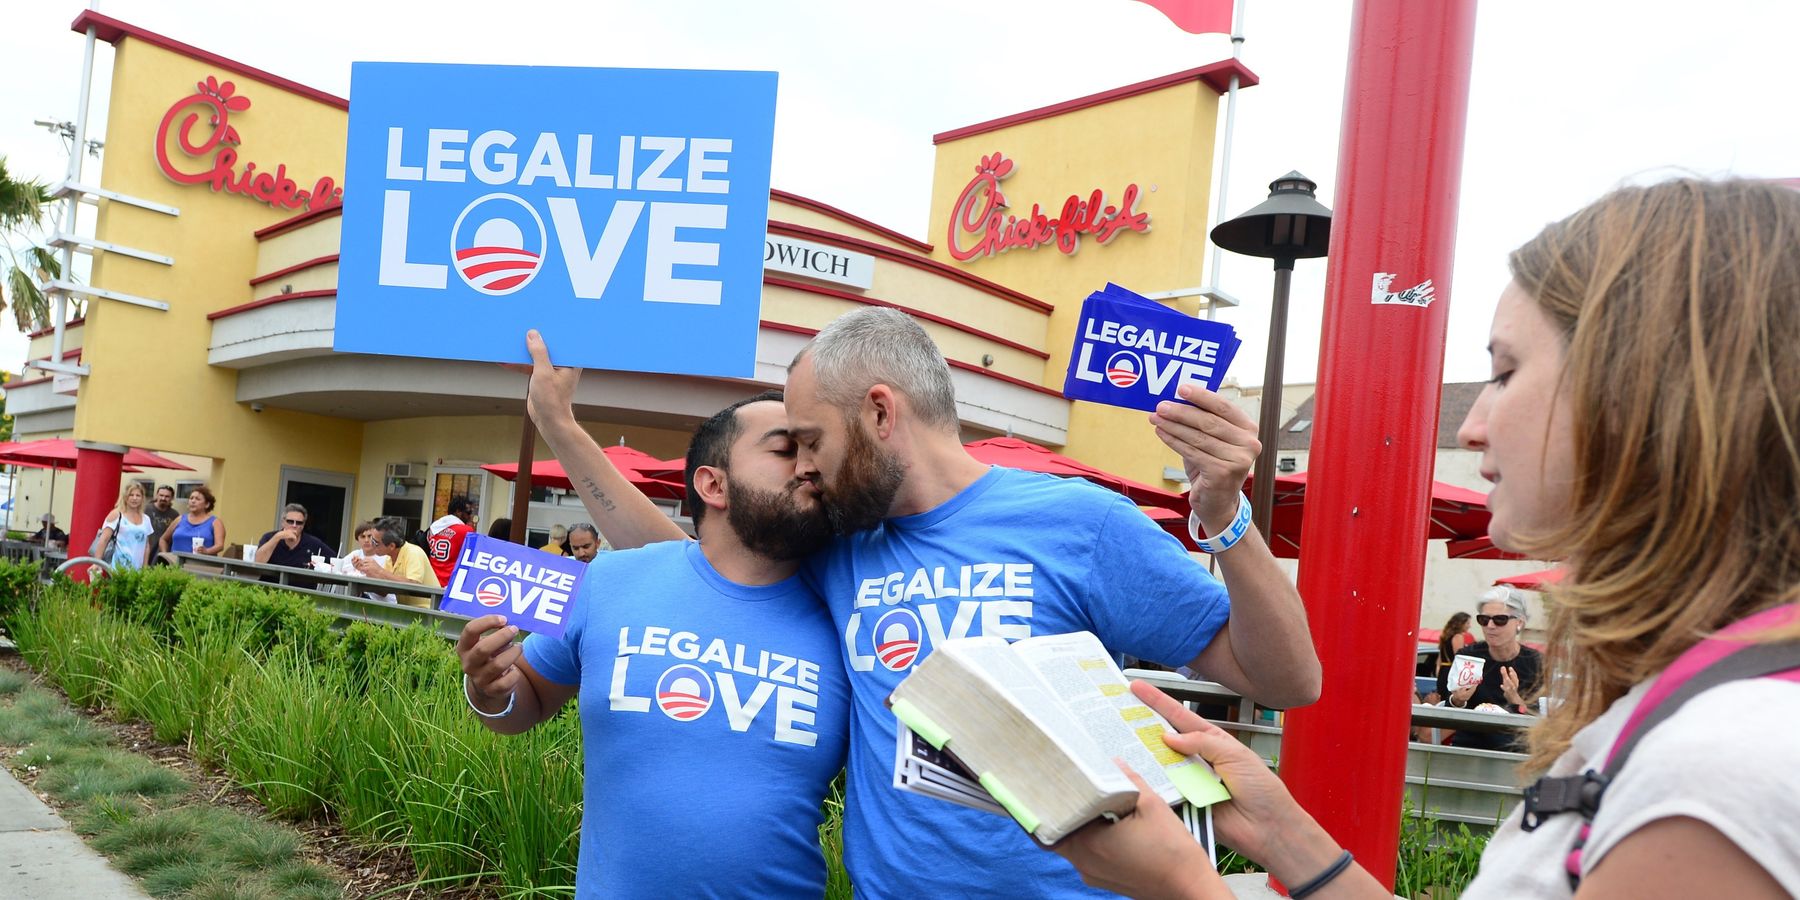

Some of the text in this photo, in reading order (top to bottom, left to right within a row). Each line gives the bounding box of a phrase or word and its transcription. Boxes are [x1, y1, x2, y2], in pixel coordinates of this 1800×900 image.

[385, 126, 733, 194] LEGALIZE
[378, 189, 728, 306] LOVE
[947, 171, 1151, 262] Chick-fil-A
[1075, 341, 1214, 400] LOVE
[1084, 317, 1220, 364] LEGALIZE
[448, 568, 569, 625] LOVE
[460, 548, 577, 592] LEGALIZE
[854, 562, 1034, 610] EGALIZE
[618, 626, 820, 692] LEGALIZE
[845, 600, 1033, 672] LOVE
[608, 656, 818, 747] LOVE
